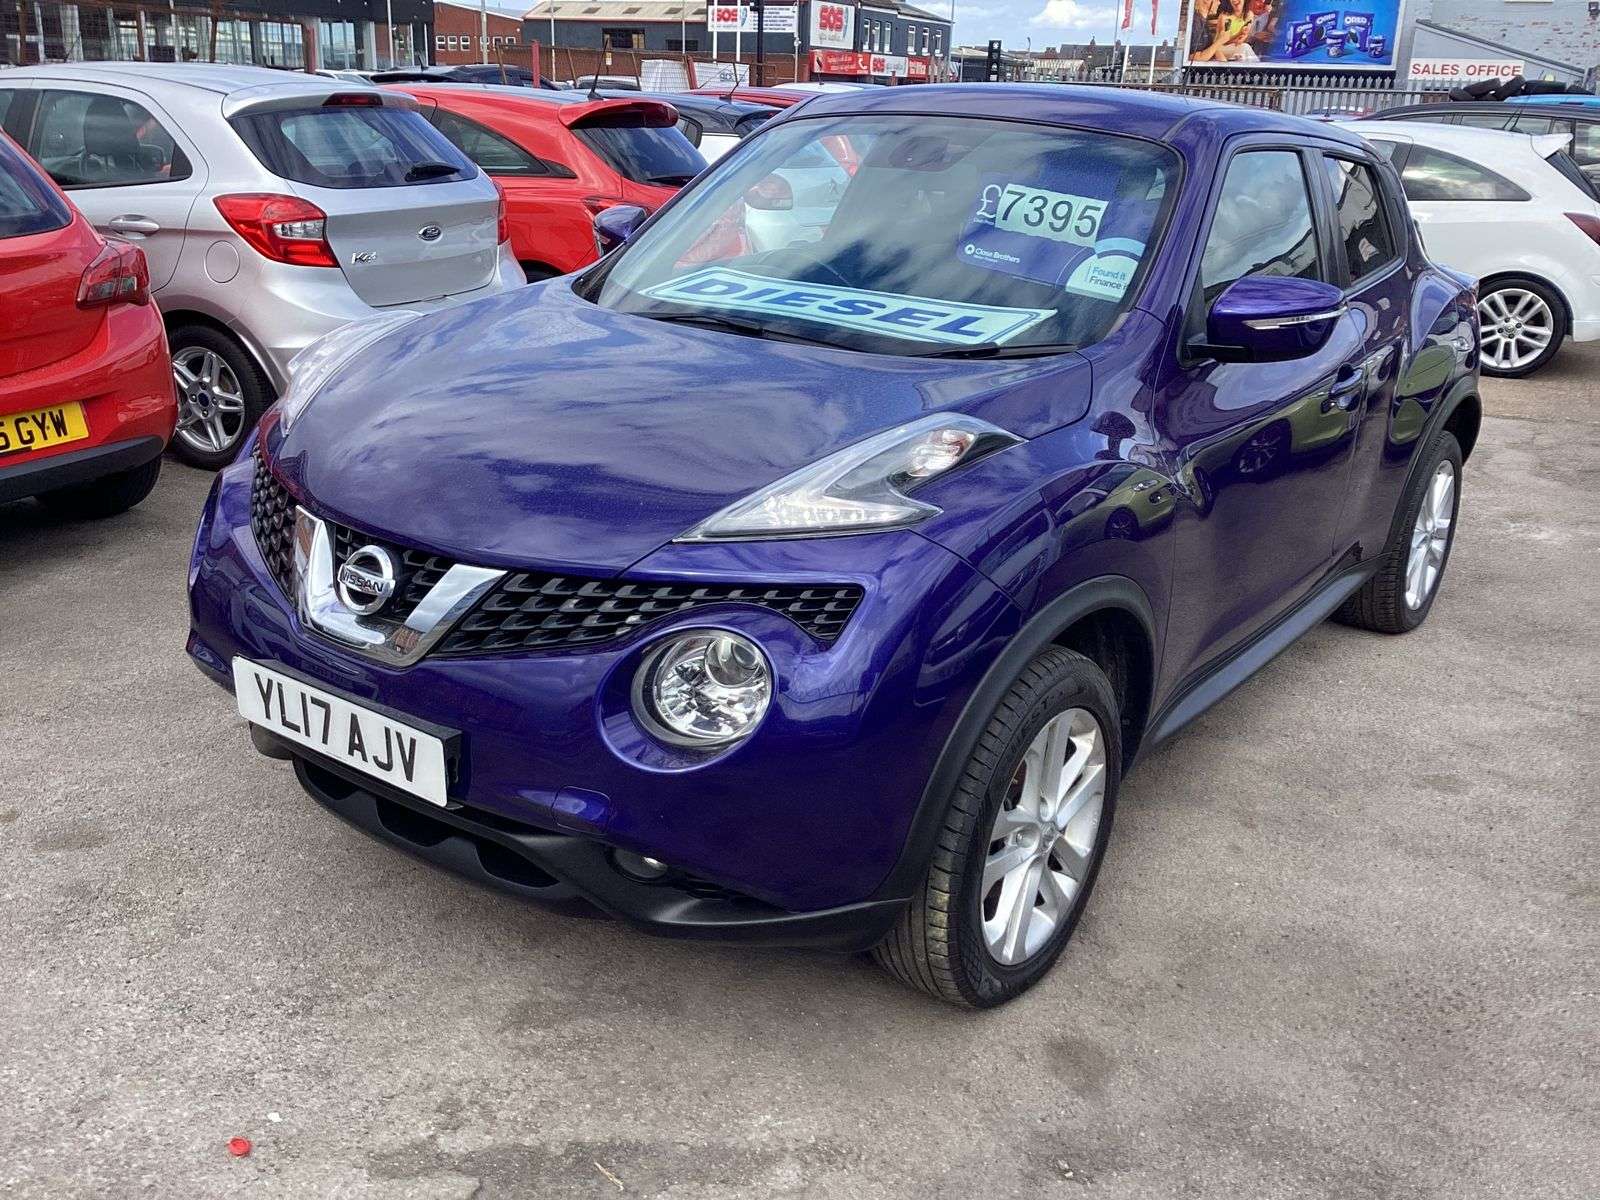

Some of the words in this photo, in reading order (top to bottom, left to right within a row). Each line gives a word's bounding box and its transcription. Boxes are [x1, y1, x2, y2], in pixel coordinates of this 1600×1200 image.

[711, 7, 738, 22] SOS
[819, 5, 843, 32] SOS
[1344, 16, 1367, 25] OREO
[1411, 63, 1460, 76] SALES
[1466, 64, 1522, 77] OFFICE
[993, 251, 1020, 264] Brothers
[1092, 266, 1120, 279] Found
[1089, 275, 1122, 290] Finance
[674, 278, 986, 337] DIESEL
[14, 408, 68, 446] GYW
[341, 567, 385, 593] NISSAN
[254, 672, 331, 746] YL17
[347, 712, 417, 783] AJV
